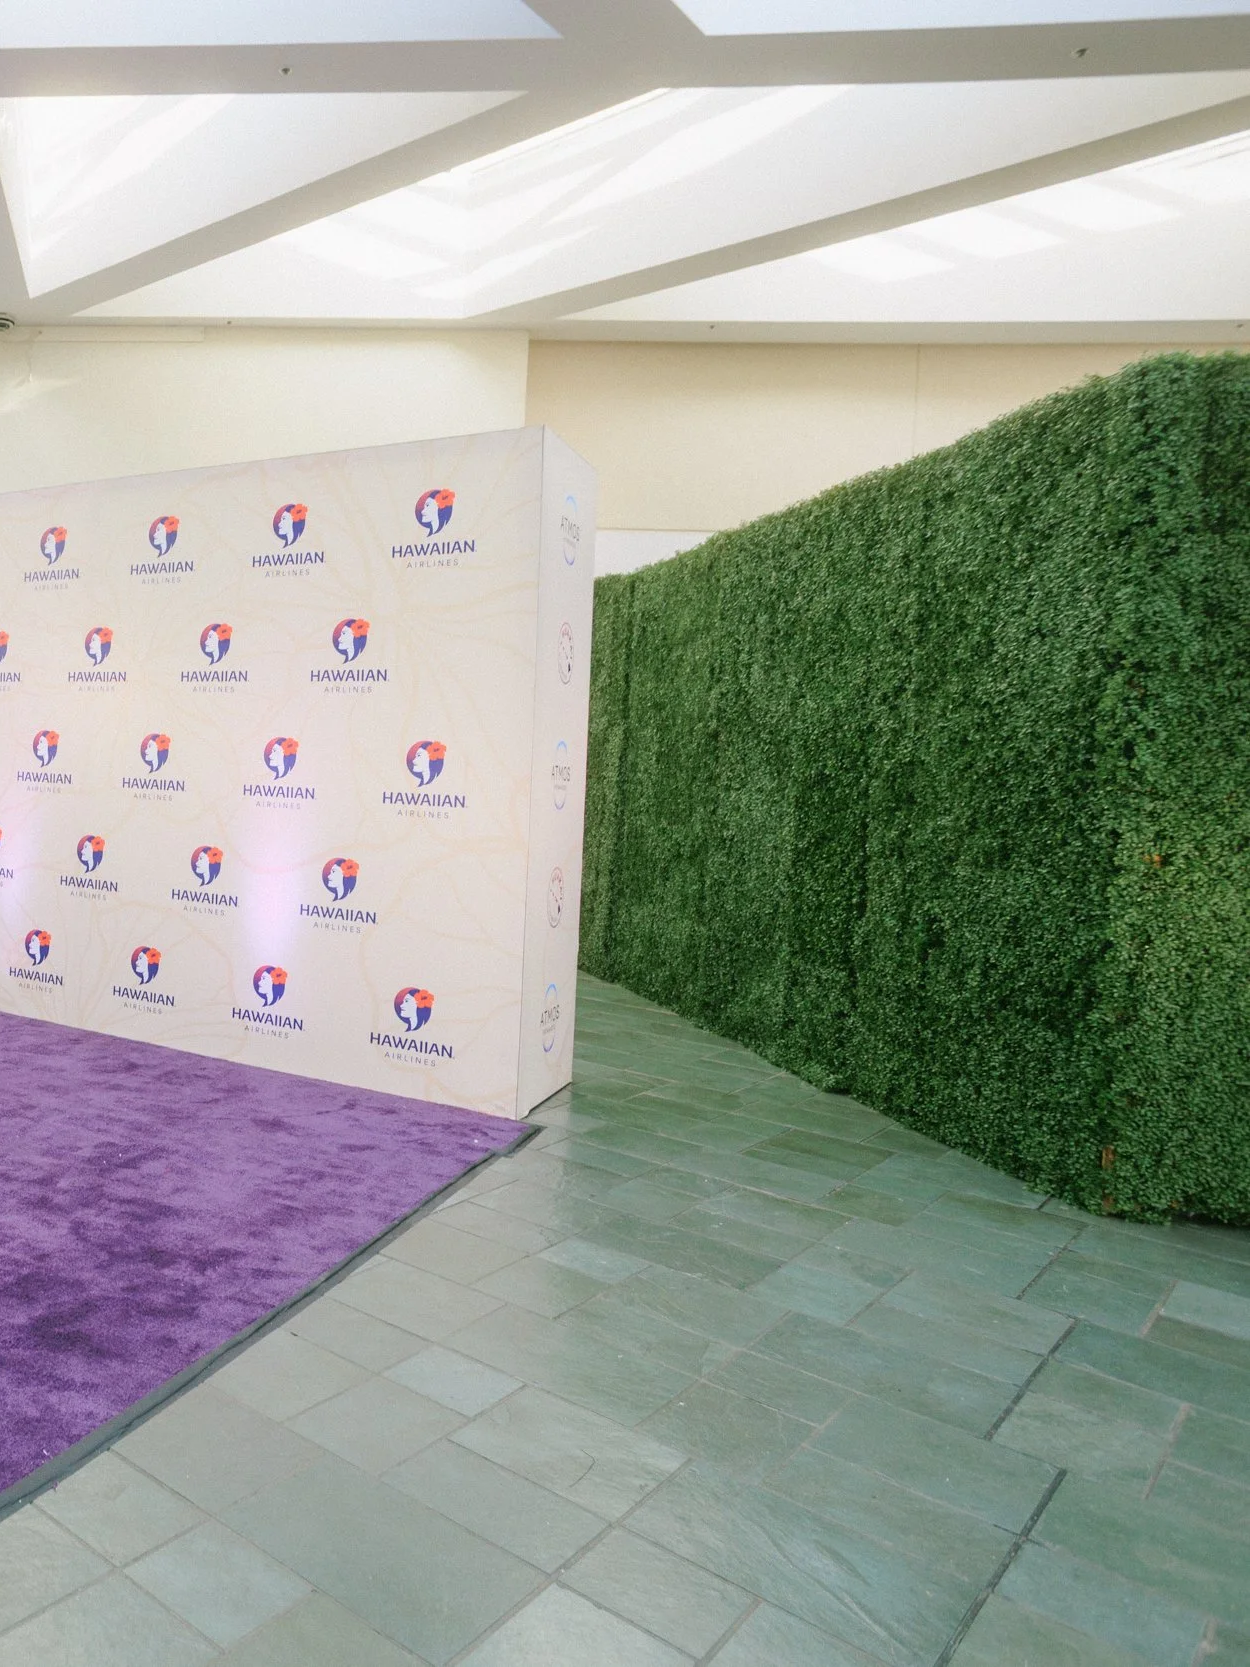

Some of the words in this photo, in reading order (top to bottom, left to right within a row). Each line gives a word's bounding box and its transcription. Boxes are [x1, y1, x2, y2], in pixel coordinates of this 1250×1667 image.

[392, 540, 474, 558] HAWAIIAN
[252, 551, 324, 567] HAWAIIAN
[403, 558, 460, 569] AIRLINES
[131, 561, 195, 575] HAWAIIAN
[263, 567, 311, 578] AIRLINES
[24, 569, 79, 582] HAWAIIAN
[141, 576, 183, 585] AIRLINES
[32, 583, 69, 591] AIRLINES
[68, 672, 126, 682] HAWAIIAN
[181, 670, 249, 682] HAWAIIAN
[311, 669, 387, 682] HAWAIIAN
[17, 771, 71, 784] HAWAIIAN
[551, 765, 570, 782] ATMOS
[25, 785, 61, 793] AIRLINES
[123, 778, 184, 791] HAWAIIAN
[132, 792, 173, 801] AIRLINES
[243, 785, 314, 799] HAWAIIAN
[253, 800, 301, 810] AIRLINES
[383, 792, 465, 808] HAWAIIAN
[395, 809, 450, 820] AIRLINES
[60, 875, 118, 892] HAWAIIAN
[69, 890, 107, 901] AIRLINES
[172, 889, 238, 907] HAWAIIAN
[182, 904, 226, 917] AIRLINES
[300, 904, 376, 924] HAWAIIAN
[311, 921, 362, 934] AIRLINES
[9, 966, 63, 986] HAWAIIAN
[17, 981, 53, 994] AIRLINES
[113, 986, 174, 1006] HAWAIIAN
[122, 1001, 163, 1015] AIRLINES
[232, 1007, 303, 1031] HAWAIIAN
[540, 1004, 560, 1027] ATMOS
[243, 1024, 290, 1040] AIRLINES
[370, 1032, 452, 1059] HAWAIIAN
[382, 1050, 437, 1068] AIRLINES
